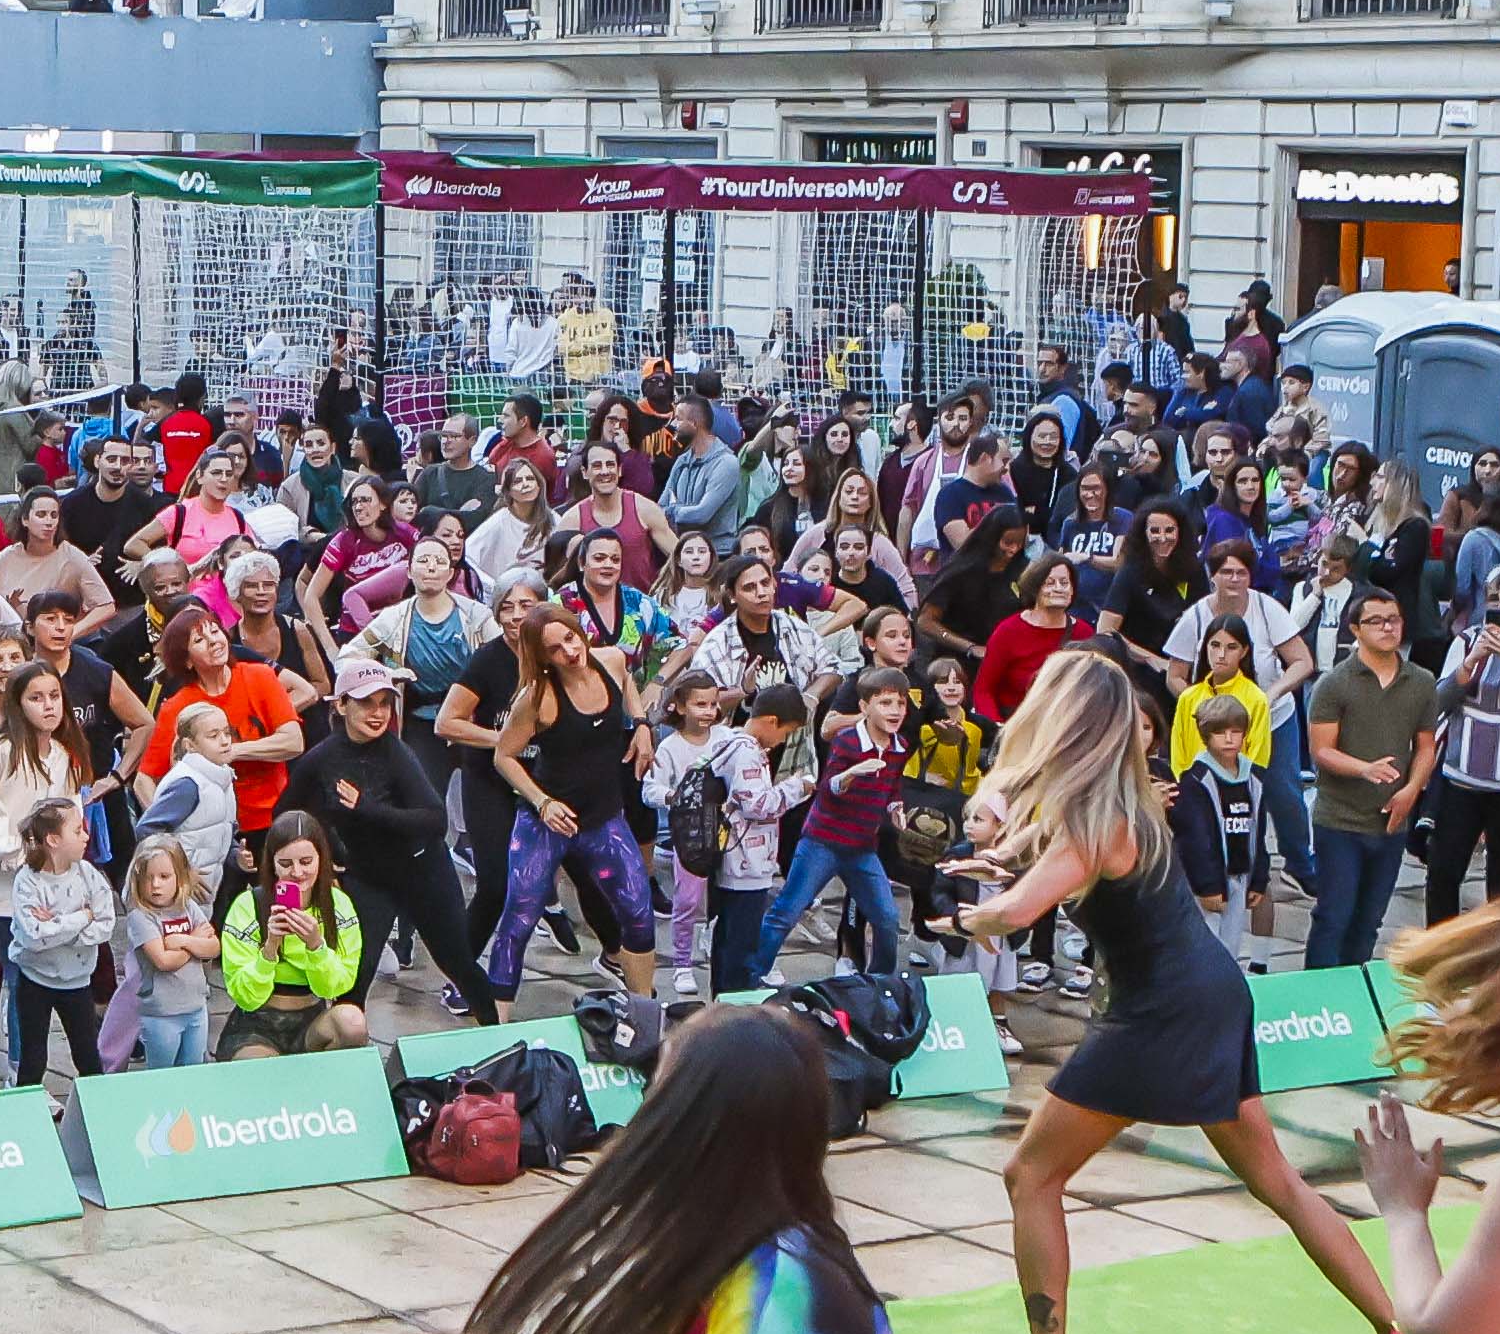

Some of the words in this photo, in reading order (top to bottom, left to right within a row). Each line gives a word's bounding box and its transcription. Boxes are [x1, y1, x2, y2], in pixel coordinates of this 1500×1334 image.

[433, 180, 502, 198] Iberdrola
[700, 174, 904, 202] #TourUniversoMujer
[1297, 168, 1460, 205] McDonald's
[1071, 531, 1114, 554] GAP
[1253, 1008, 1353, 1045] erdrola
[201, 1103, 358, 1151] Iberdrola
